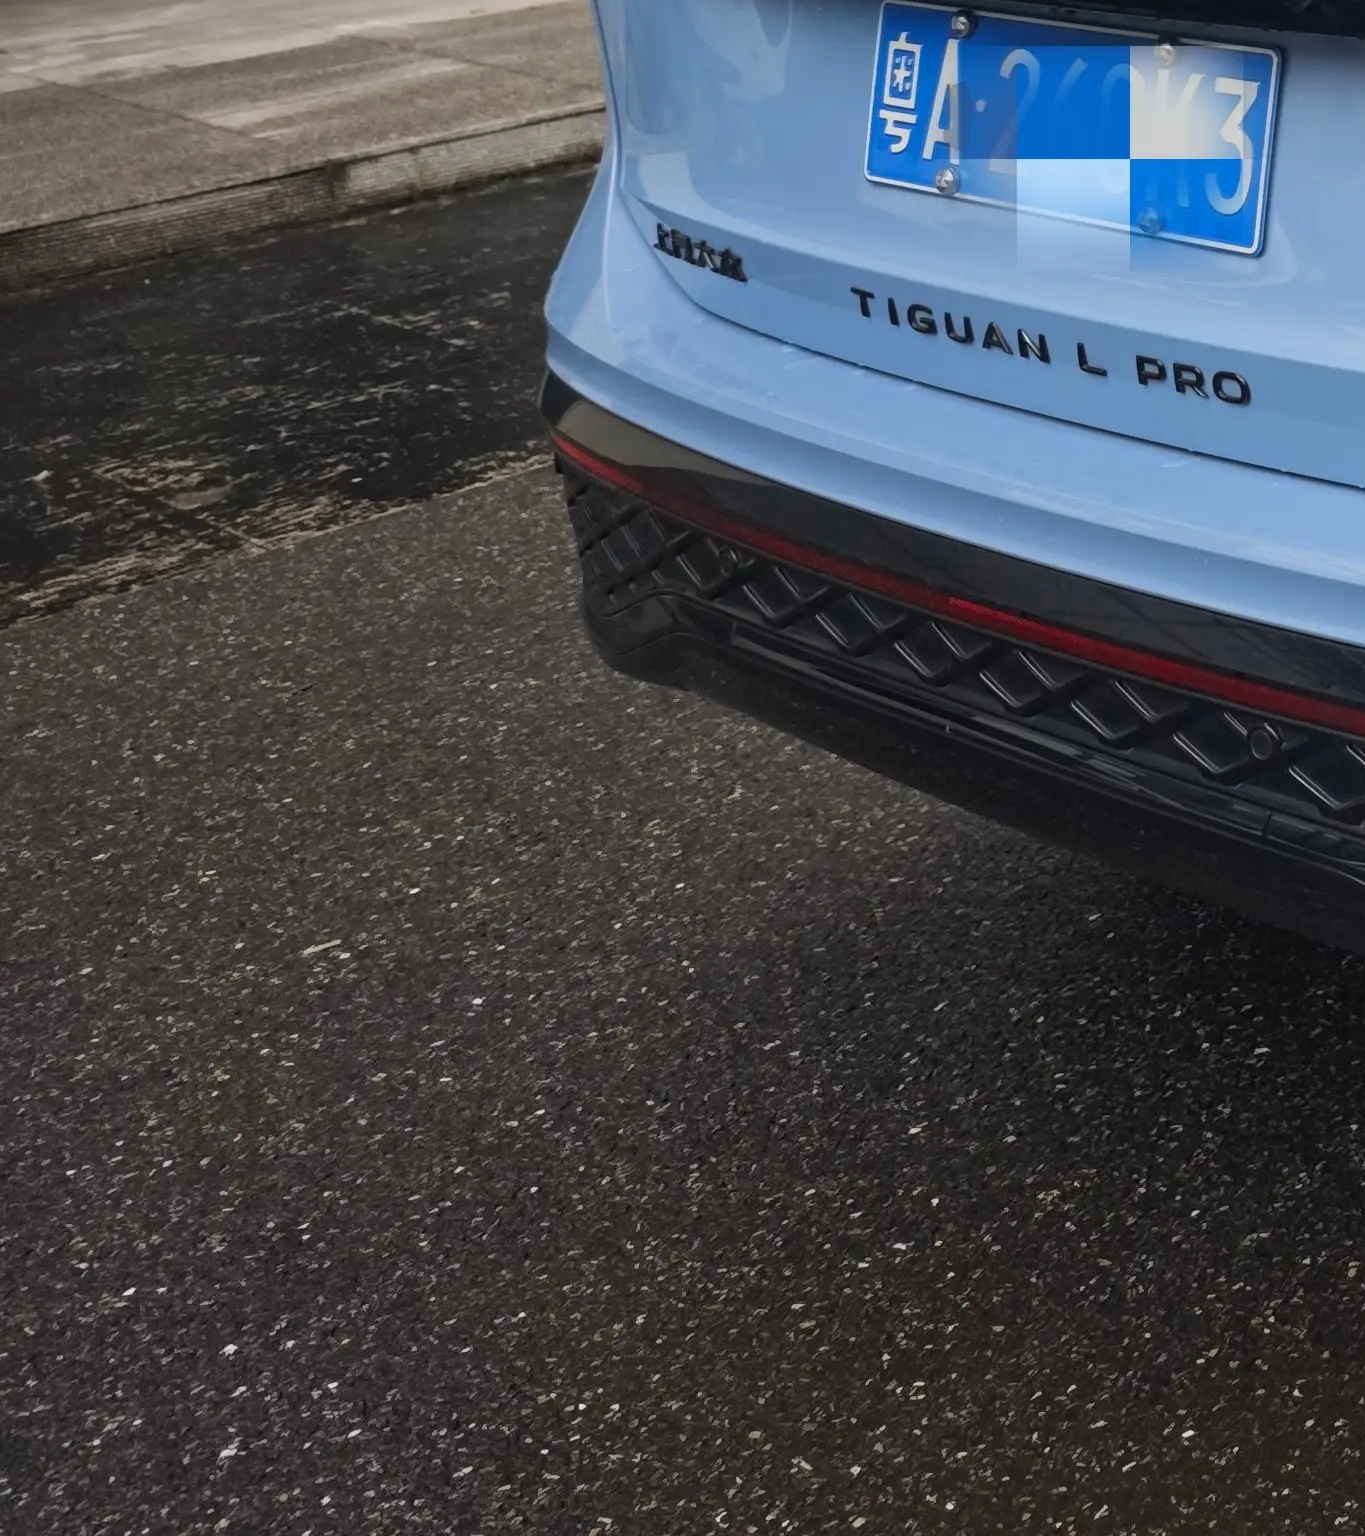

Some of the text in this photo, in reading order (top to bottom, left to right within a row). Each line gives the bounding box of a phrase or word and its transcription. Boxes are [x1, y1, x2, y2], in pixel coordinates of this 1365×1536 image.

[850, 286, 1252, 406] TIGUAN L PRO
